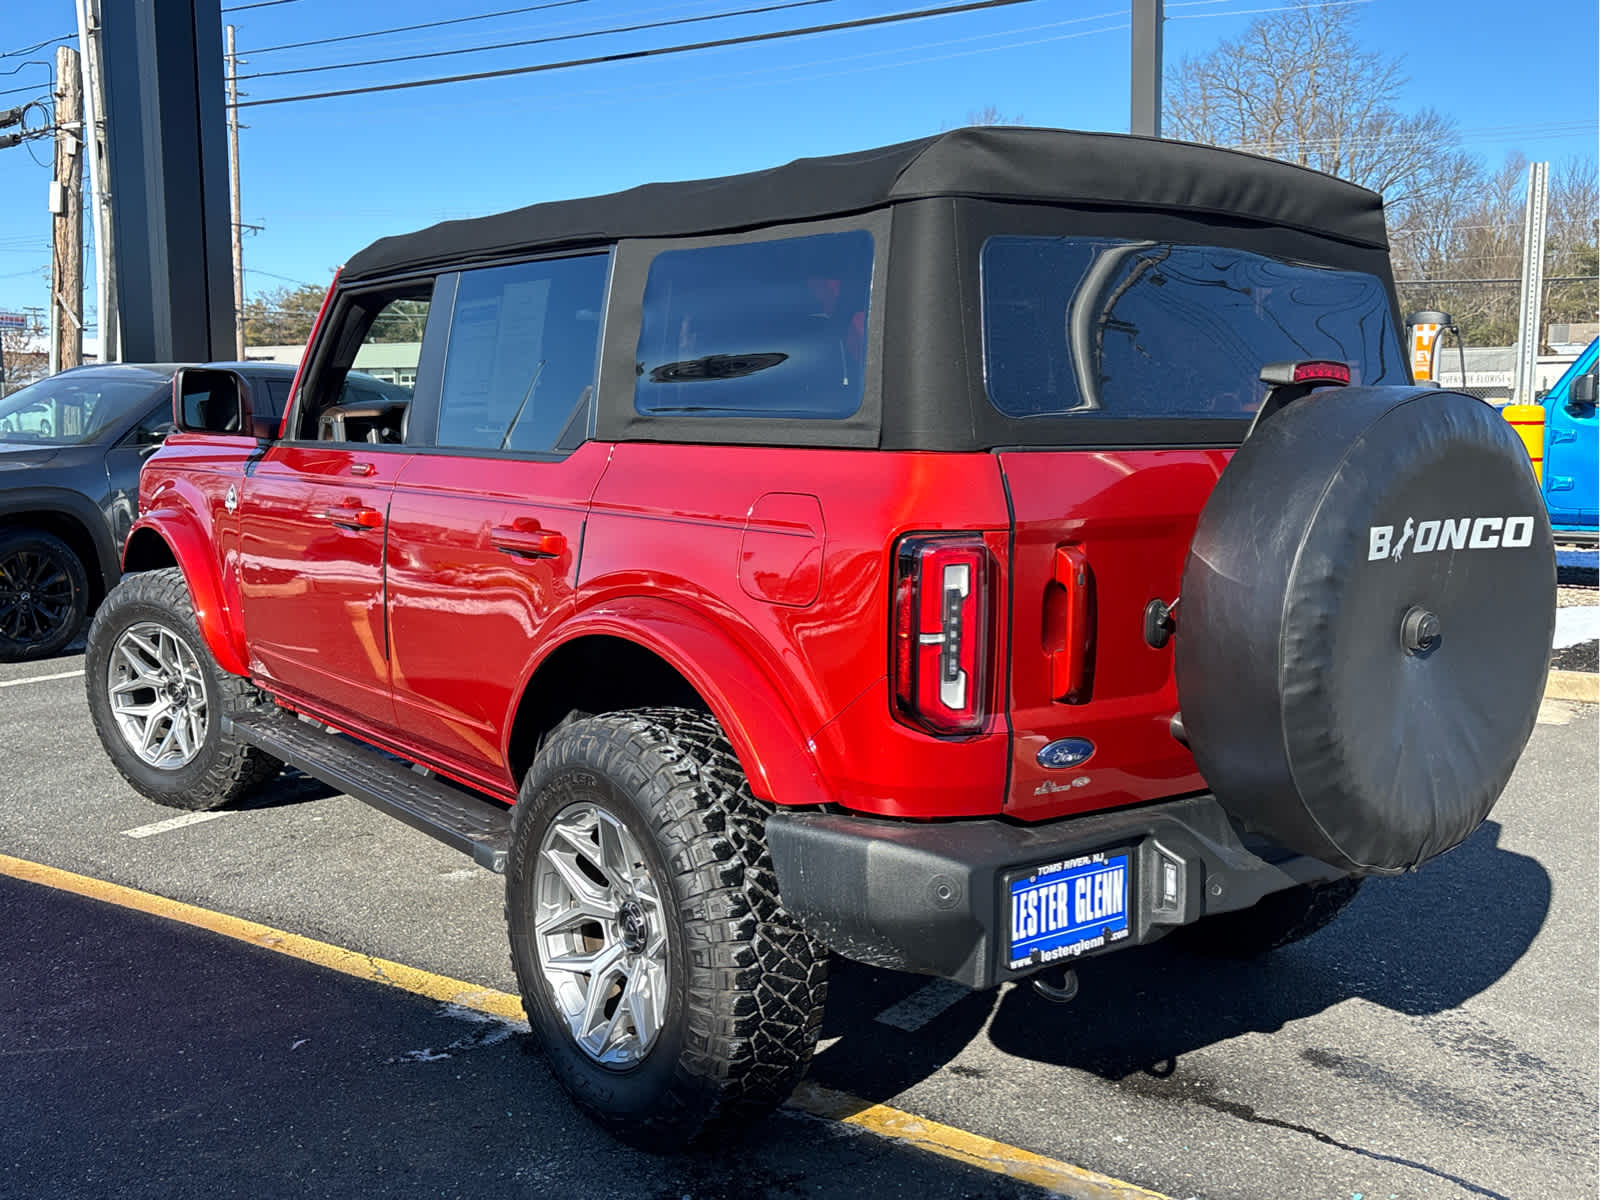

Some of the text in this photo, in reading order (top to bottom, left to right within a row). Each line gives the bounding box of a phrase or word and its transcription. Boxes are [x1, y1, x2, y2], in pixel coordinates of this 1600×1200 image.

[1037, 864, 1062, 877] TOMS
[1092, 852, 1105, 863] NJ
[1012, 868, 1124, 941] LESTER GLENN
